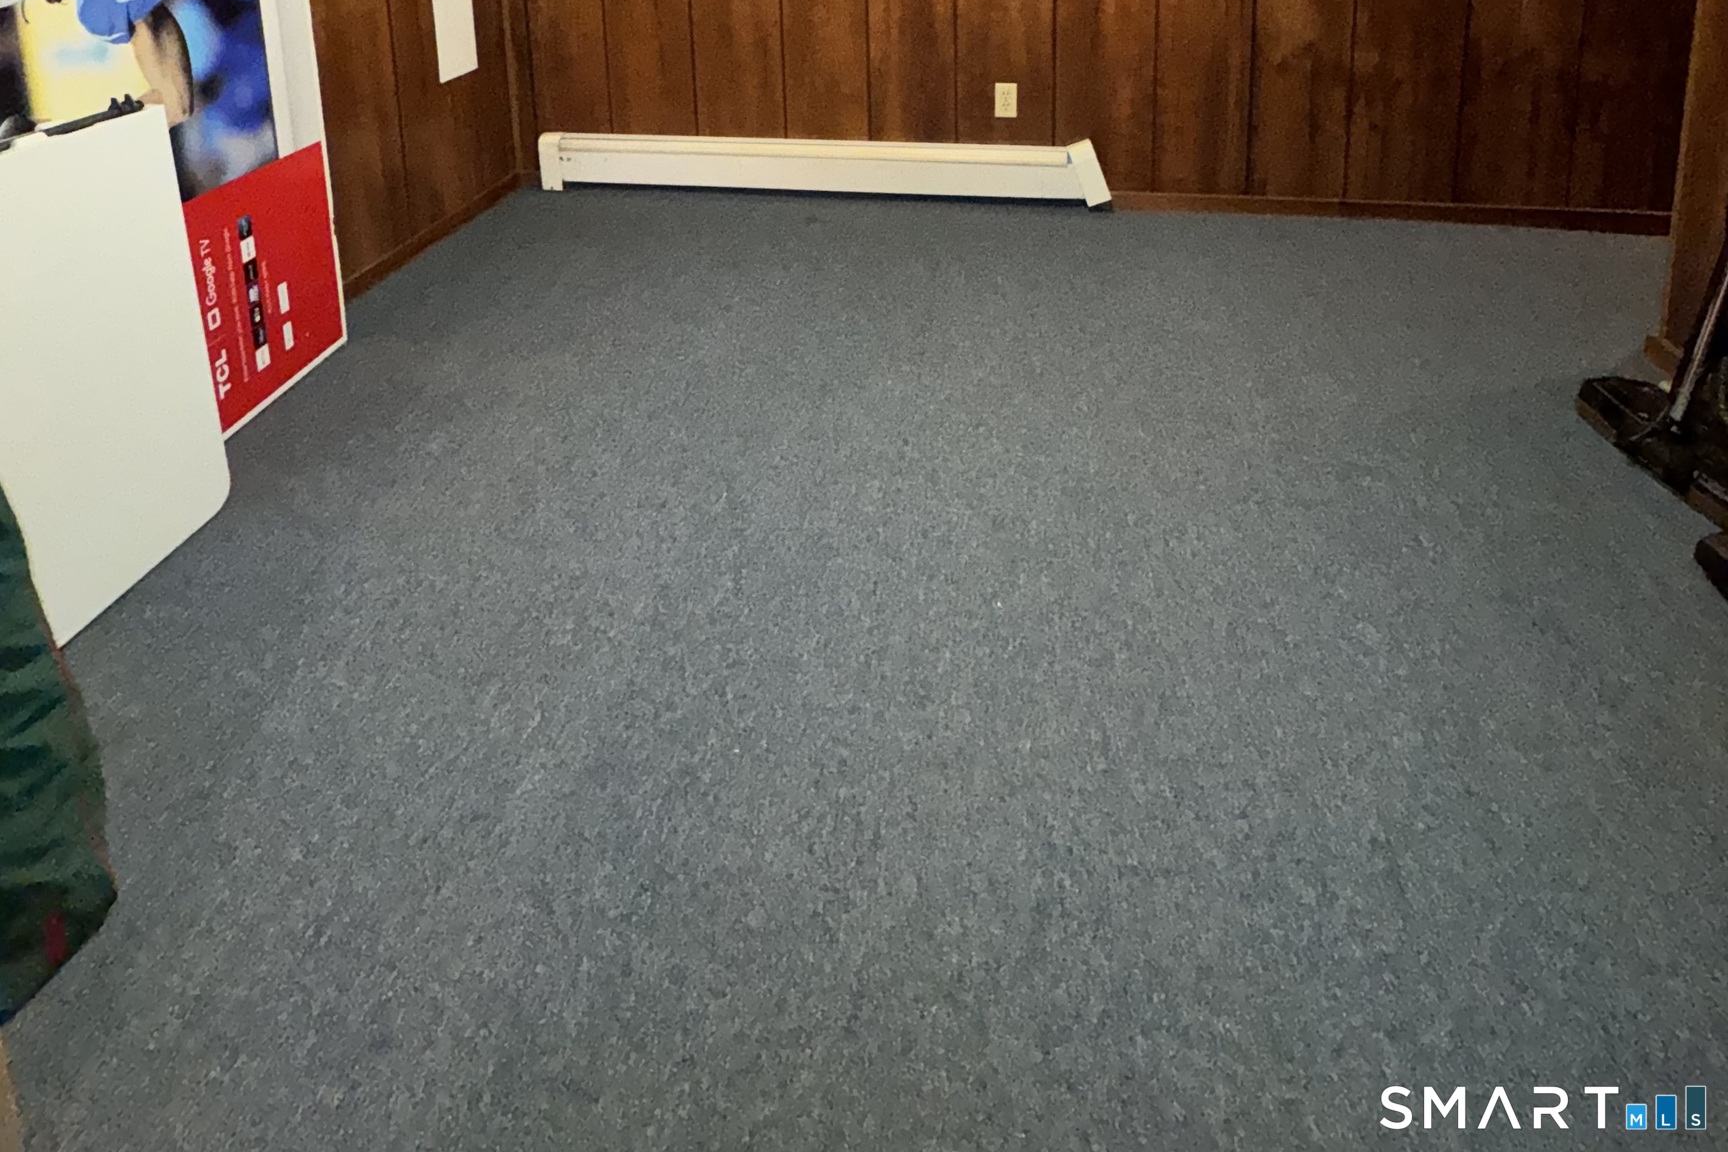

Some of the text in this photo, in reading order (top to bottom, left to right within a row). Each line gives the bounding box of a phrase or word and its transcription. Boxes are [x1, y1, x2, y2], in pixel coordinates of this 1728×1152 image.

[199, 239, 217, 306] Google TV
[215, 349, 232, 399] TCL
